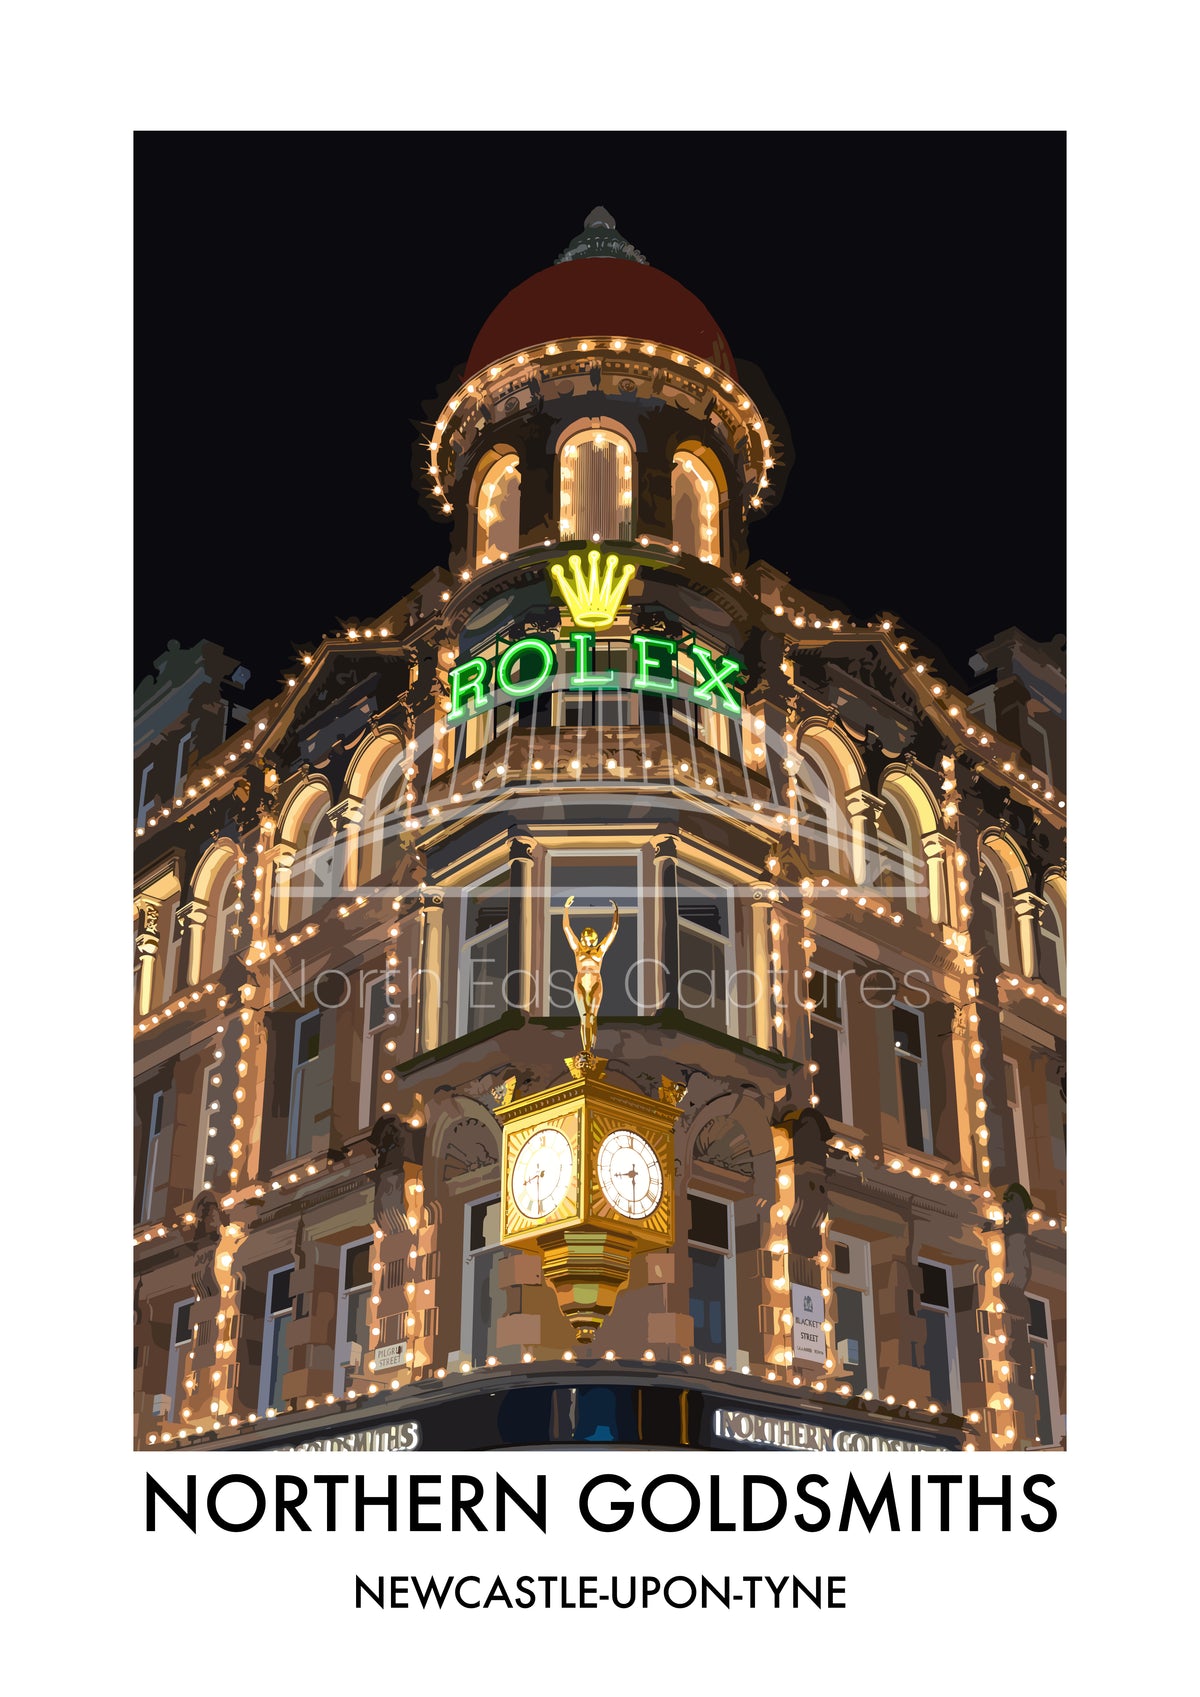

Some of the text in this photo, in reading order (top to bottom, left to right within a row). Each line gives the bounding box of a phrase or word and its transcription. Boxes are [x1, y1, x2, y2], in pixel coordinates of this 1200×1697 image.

[447, 632, 742, 722] ROLEX
[800, 1332, 819, 1343] STREET
[377, 1345, 402, 1359] PILGRI
[379, 1355, 401, 1368] STREET
[715, 1409, 951, 1451] NORTHERN GOLDS
